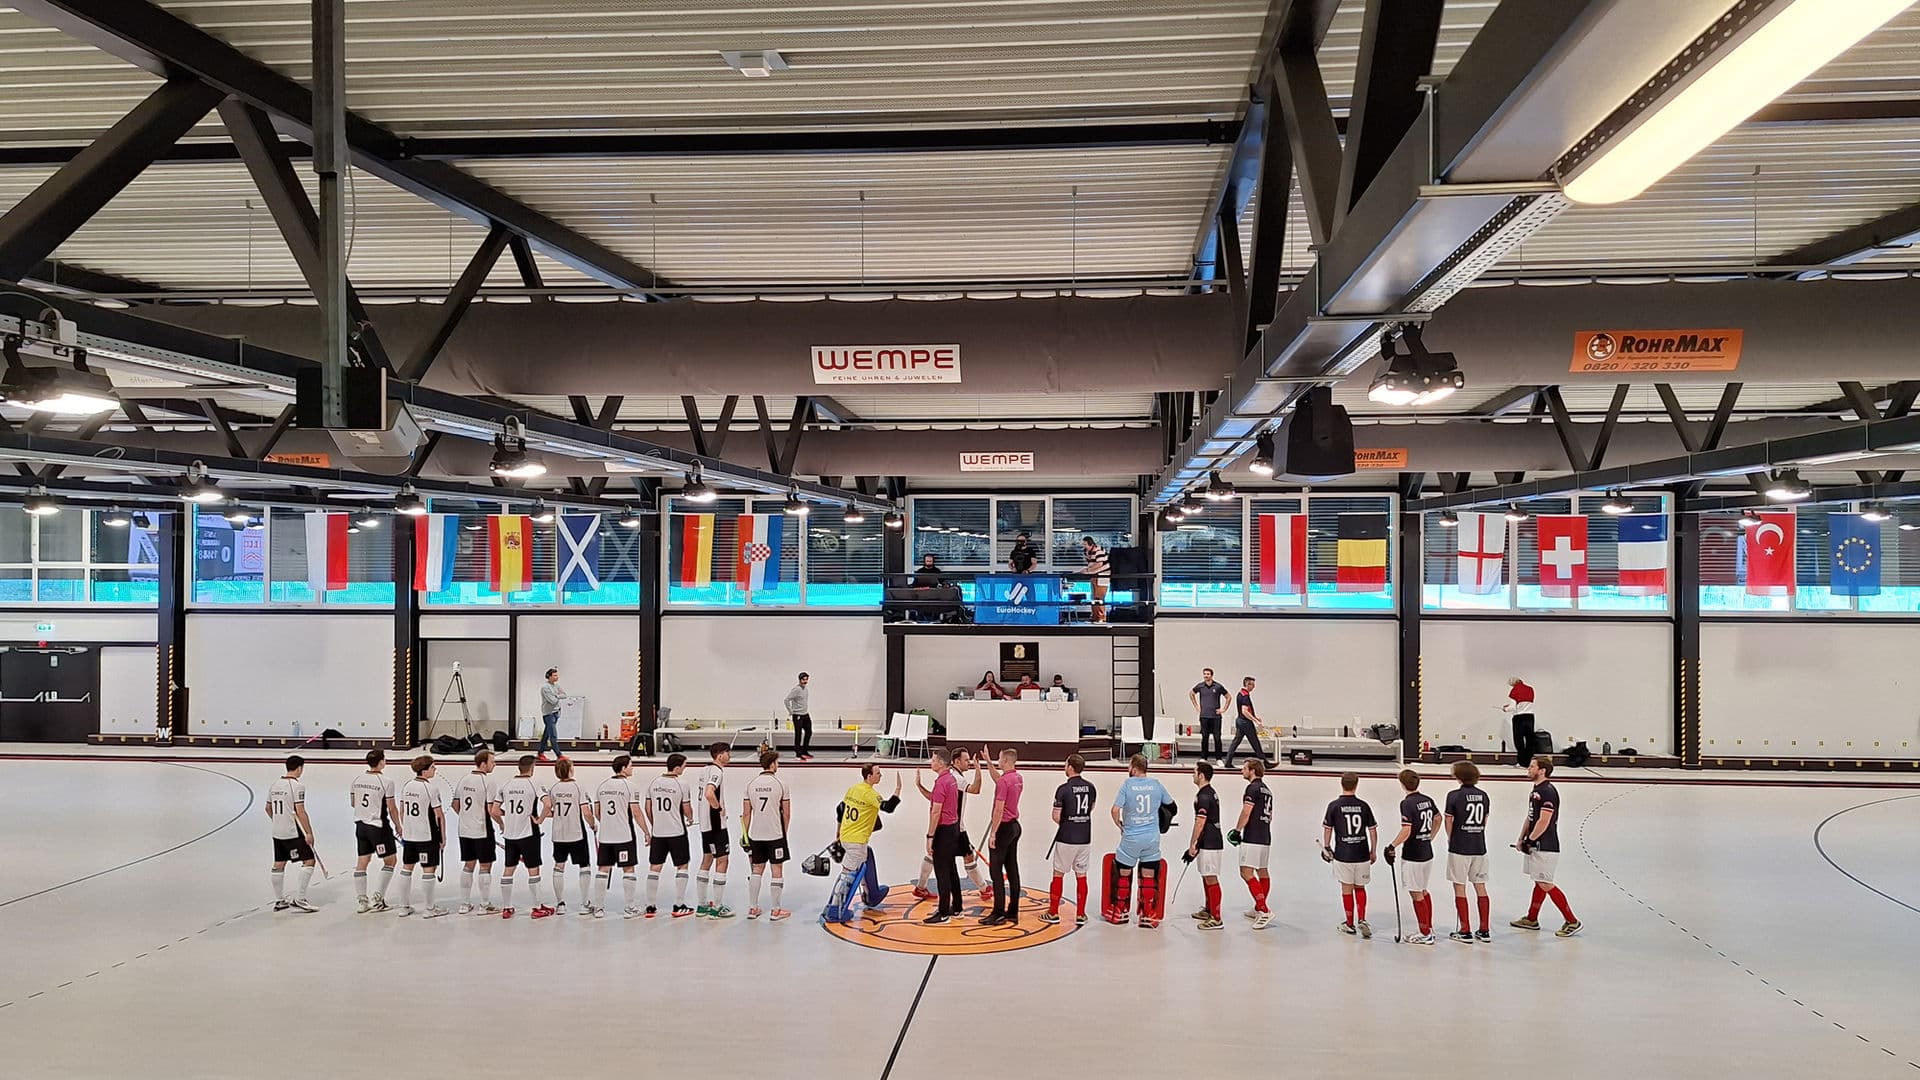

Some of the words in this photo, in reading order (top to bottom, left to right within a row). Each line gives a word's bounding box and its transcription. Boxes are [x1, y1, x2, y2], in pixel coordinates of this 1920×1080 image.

[817, 349, 954, 370] WEMPE
[1583, 362, 1619, 371] 0820
[1631, 362, 1659, 370] 320
[1662, 361, 1690, 370] 330
[963, 454, 1031, 465] WEMPE
[996, 606, 1036, 615] EuroHockey
[273, 800, 283, 815] 11
[361, 793, 370, 808] 5
[405, 801, 420, 816] 18
[464, 796, 473, 811] 9
[509, 799, 524, 815] 16
[607, 800, 616, 816] 3
[656, 796, 672, 811] 10
[759, 796, 769, 812] 7
[1075, 794, 1089, 815] 14
[1135, 794, 1151, 814] 31
[555, 802, 572, 817] 17
[845, 804, 859, 822] 30
[1465, 802, 1484, 825] 20
[1344, 814, 1362, 835] 19
[1419, 809, 1433, 833] 28
